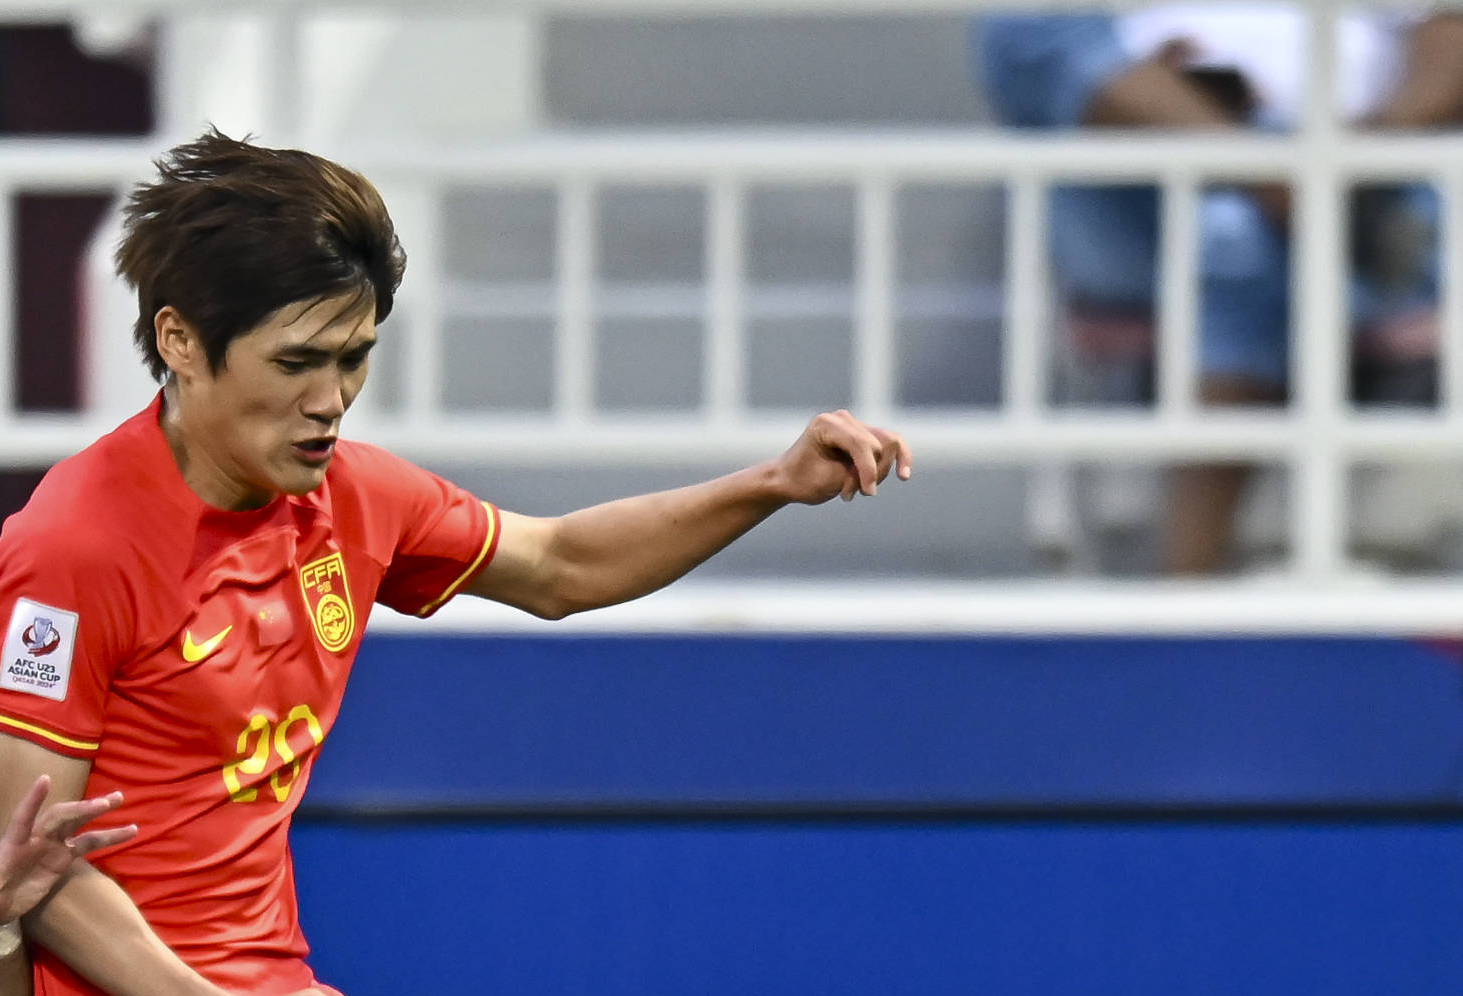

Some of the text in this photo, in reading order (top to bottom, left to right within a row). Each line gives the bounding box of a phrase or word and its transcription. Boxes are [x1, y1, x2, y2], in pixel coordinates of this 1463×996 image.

[303, 560, 341, 589] CFA
[8, 666, 61, 682] ASIAN CUP
[15, 658, 56, 673] AFC U23
[222, 703, 324, 803] 20
